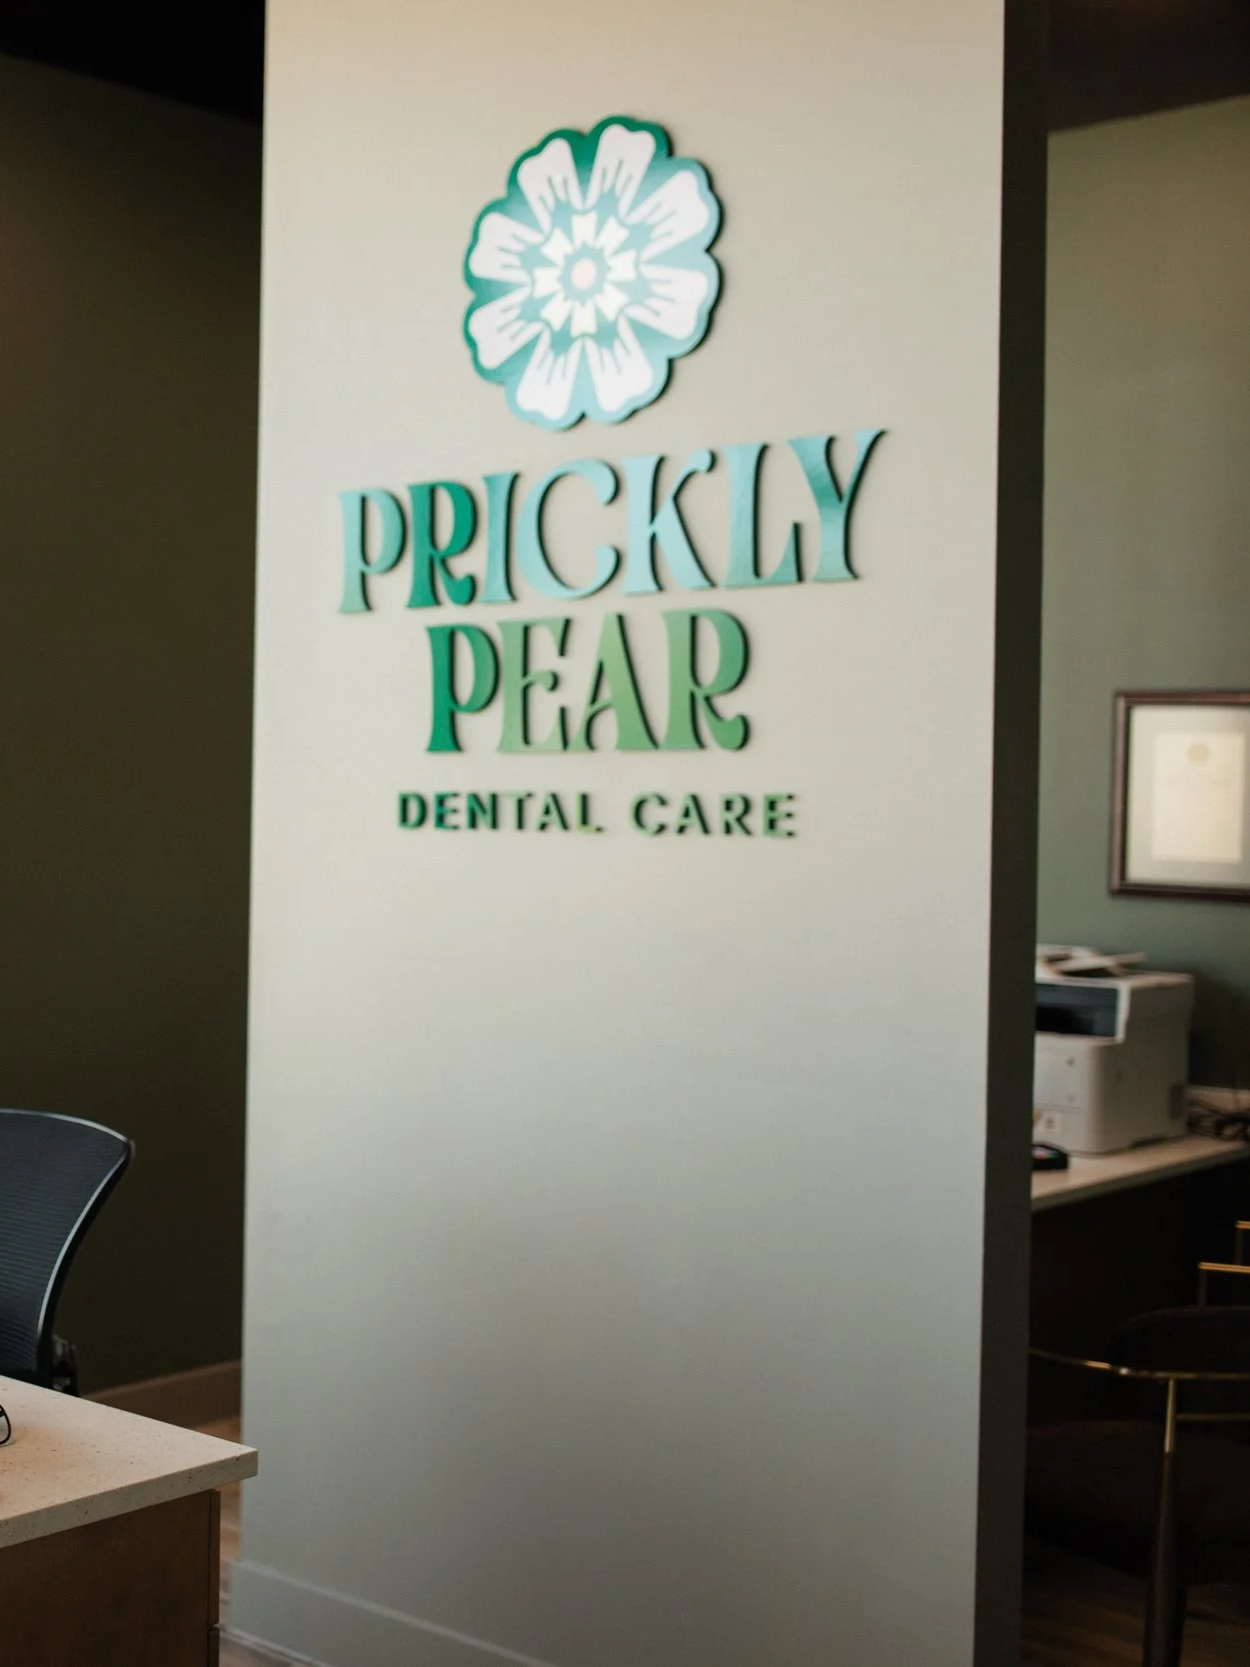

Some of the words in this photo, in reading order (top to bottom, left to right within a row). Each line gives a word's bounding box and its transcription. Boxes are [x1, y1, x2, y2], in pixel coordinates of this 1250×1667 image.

[337, 429, 886, 614] PRICKLY
[425, 608, 751, 754] PEAR
[397, 792, 604, 834] DENTAL
[629, 793, 797, 838] CARE
